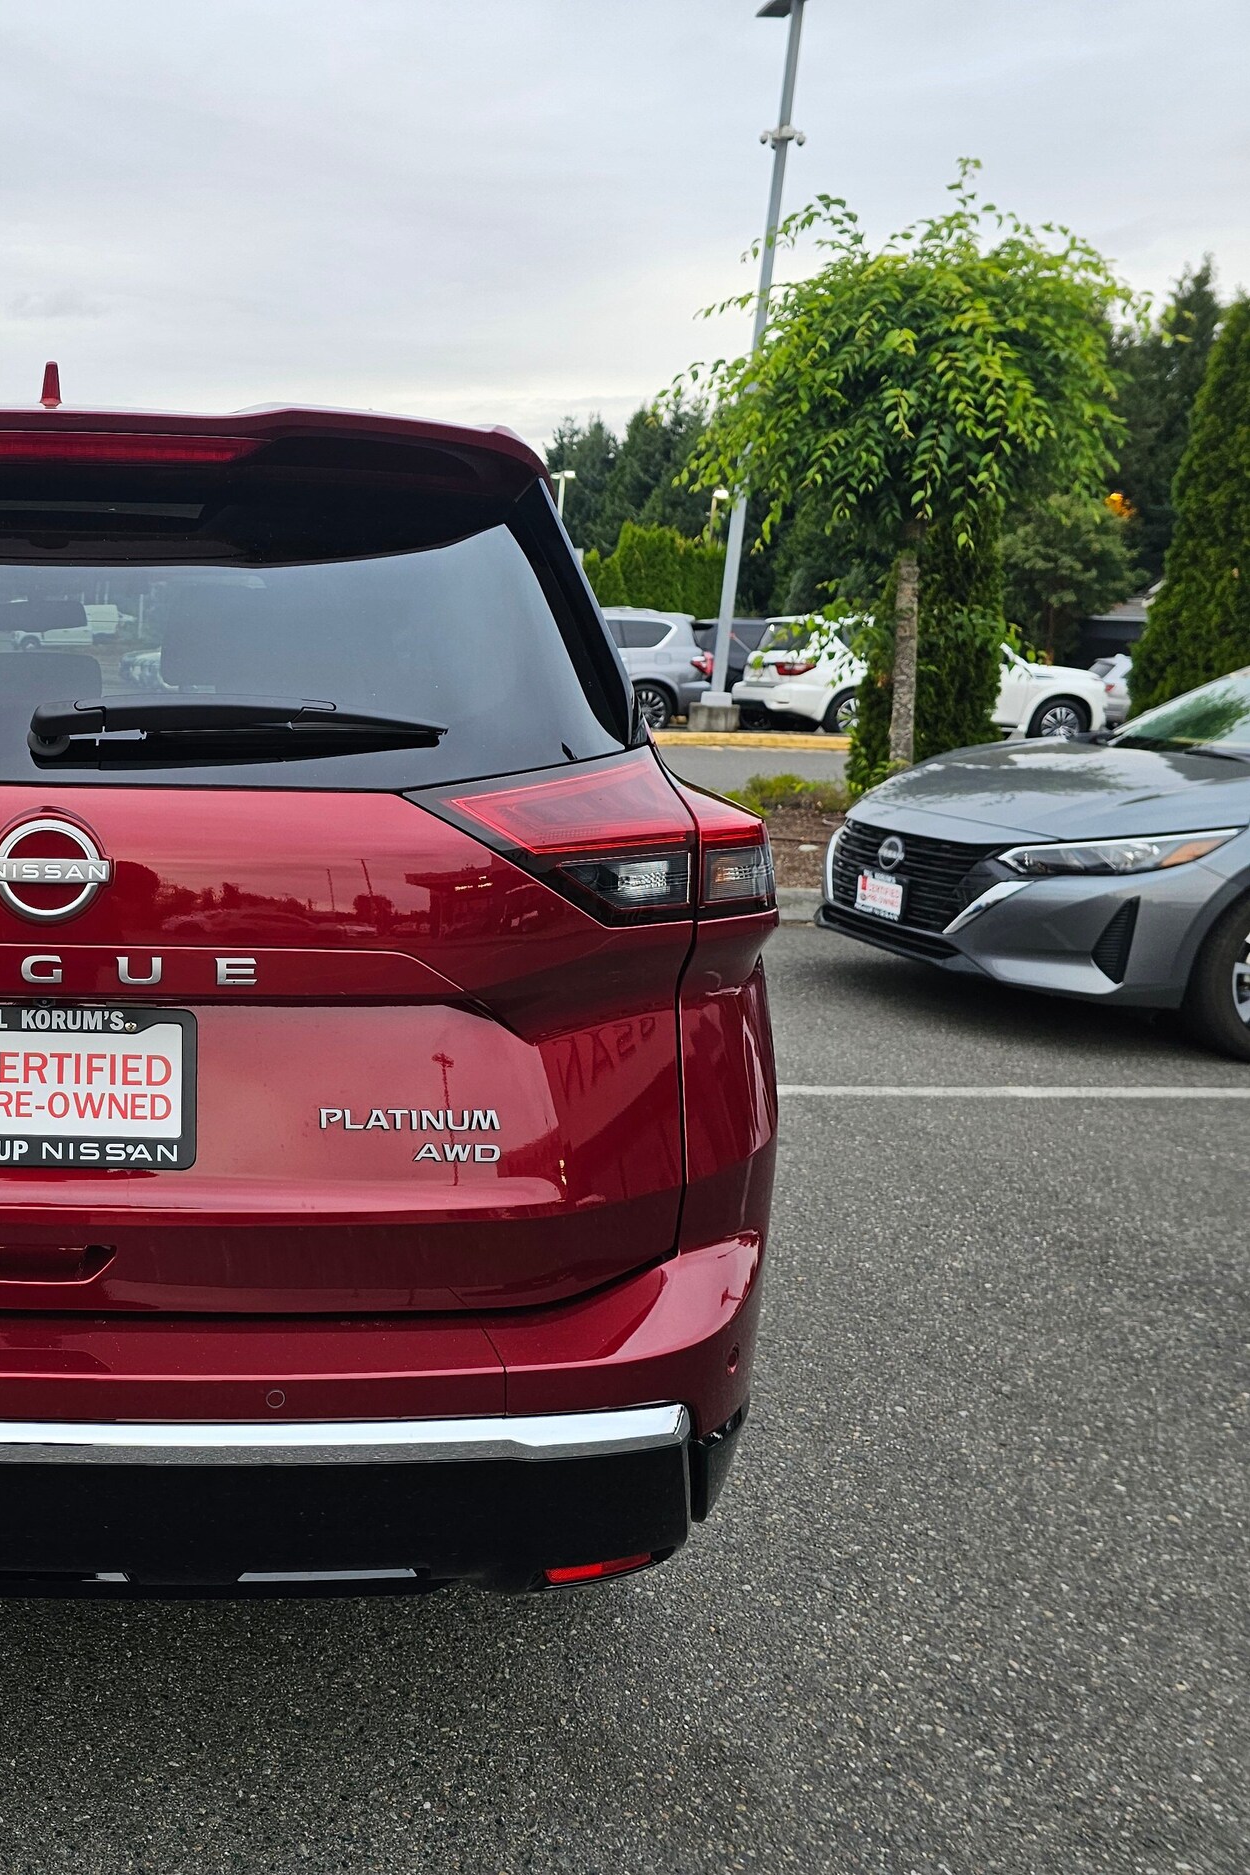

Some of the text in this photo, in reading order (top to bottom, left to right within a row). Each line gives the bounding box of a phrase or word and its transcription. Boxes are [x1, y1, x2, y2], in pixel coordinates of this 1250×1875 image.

[21, 1009, 124, 1031] KORUM'S
[319, 1108, 501, 1132] PLATINUM
[42, 1142, 178, 1162] NISSAN
[414, 1143, 501, 1162] AWD
